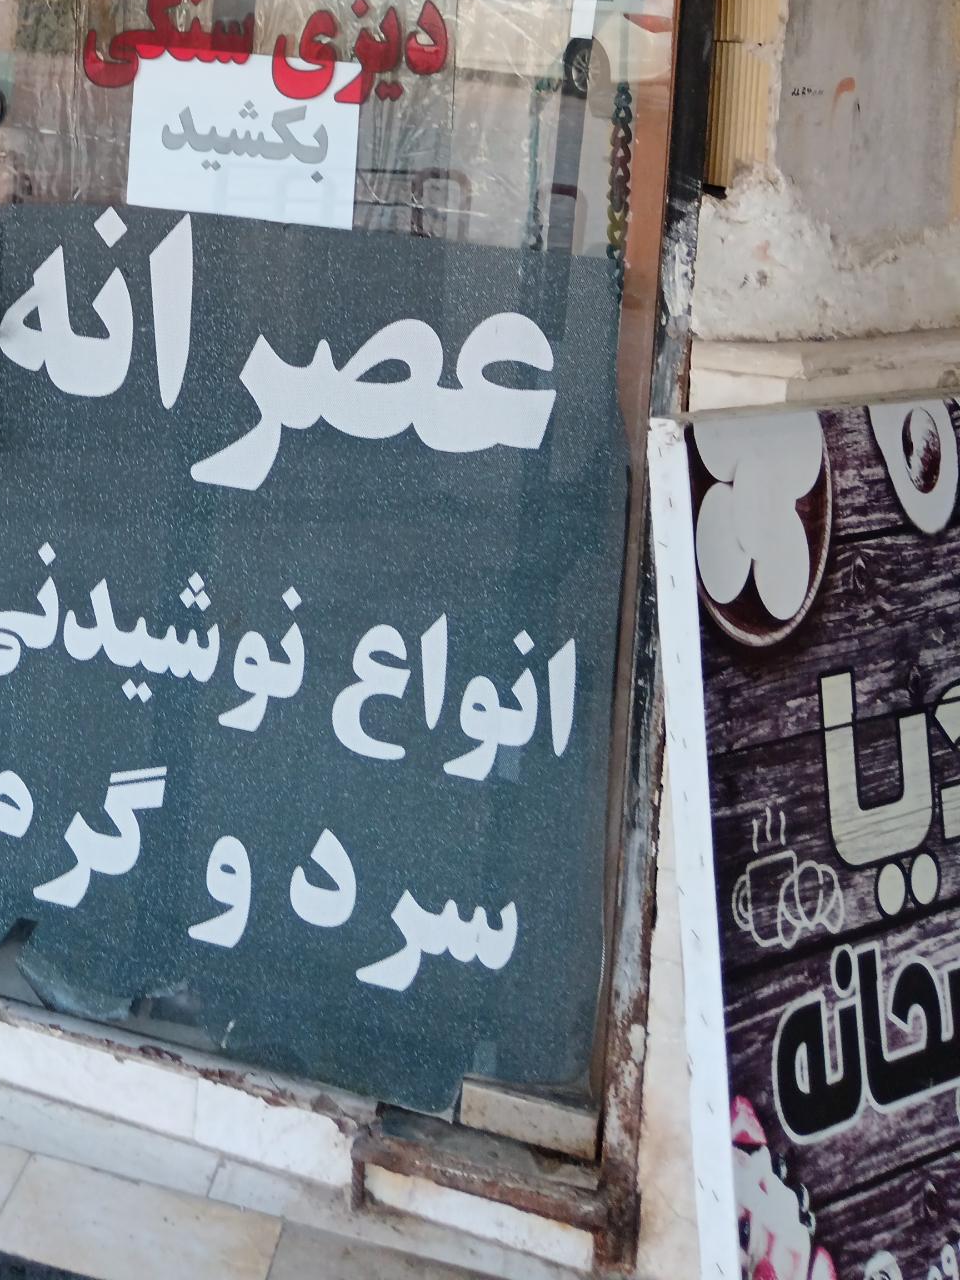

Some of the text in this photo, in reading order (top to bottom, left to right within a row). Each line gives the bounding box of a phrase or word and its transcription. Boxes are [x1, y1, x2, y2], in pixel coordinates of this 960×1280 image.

[160, 99, 329, 183] بکشید
[331, 612, 576, 780] انواع
[187, 834, 252, 949] و
[289, 826, 519, 992] سرد
